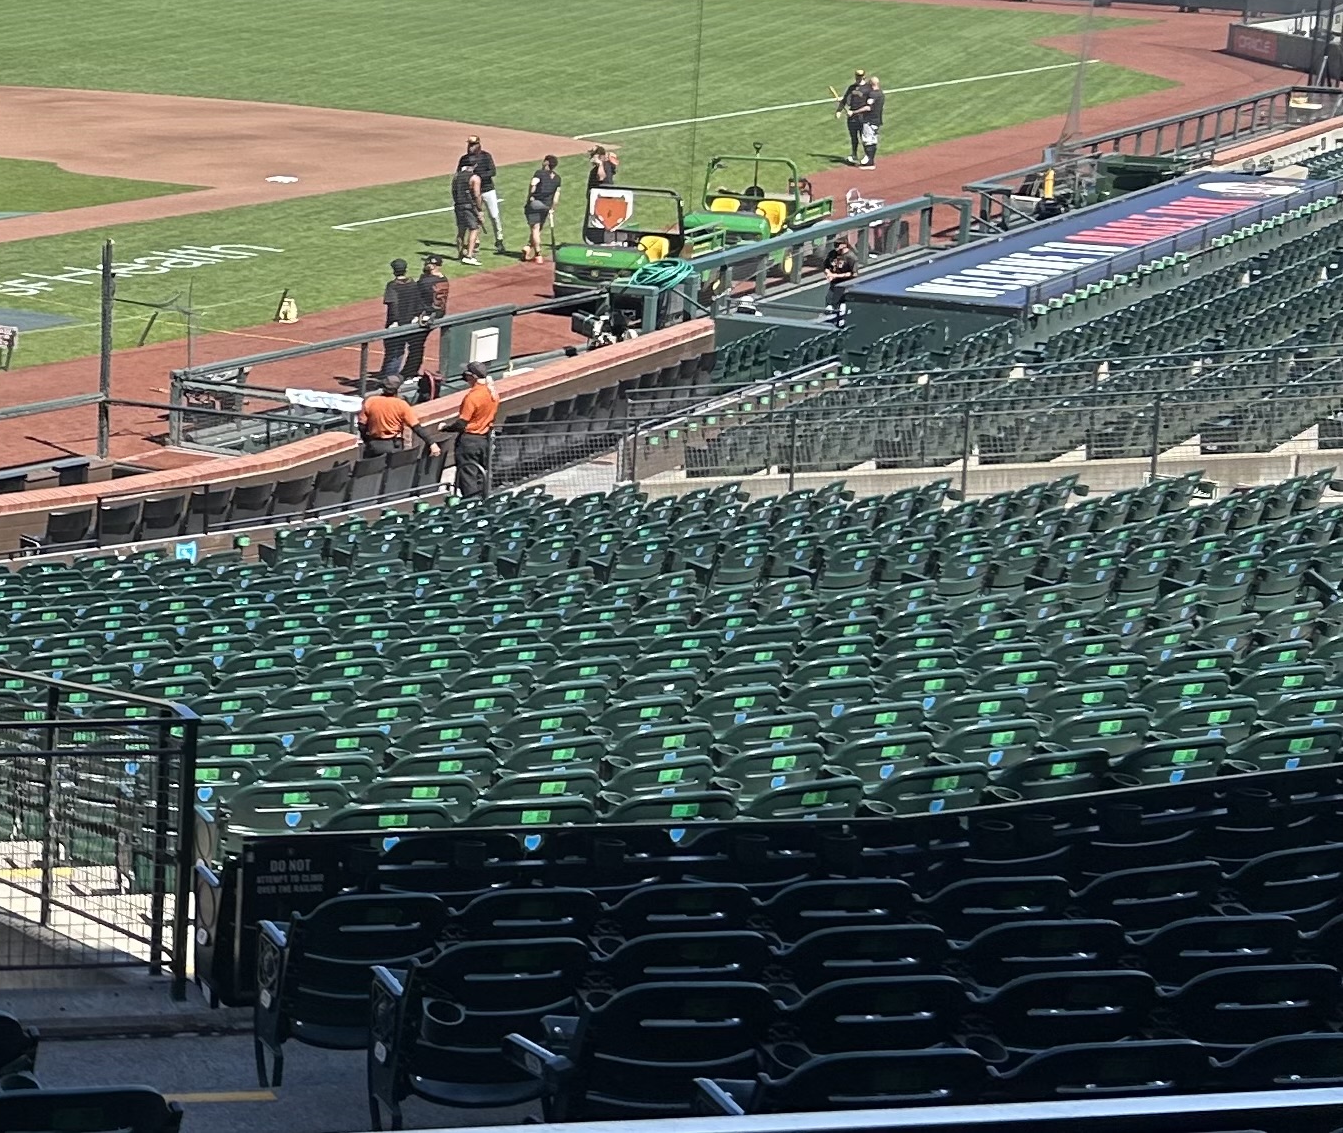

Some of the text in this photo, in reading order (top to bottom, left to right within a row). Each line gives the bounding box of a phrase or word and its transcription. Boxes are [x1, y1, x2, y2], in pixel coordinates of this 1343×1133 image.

[21, 243, 285, 285] Health
[904, 251, 1099, 298] WELCOME
[270, 858, 311, 873] DO NOT
